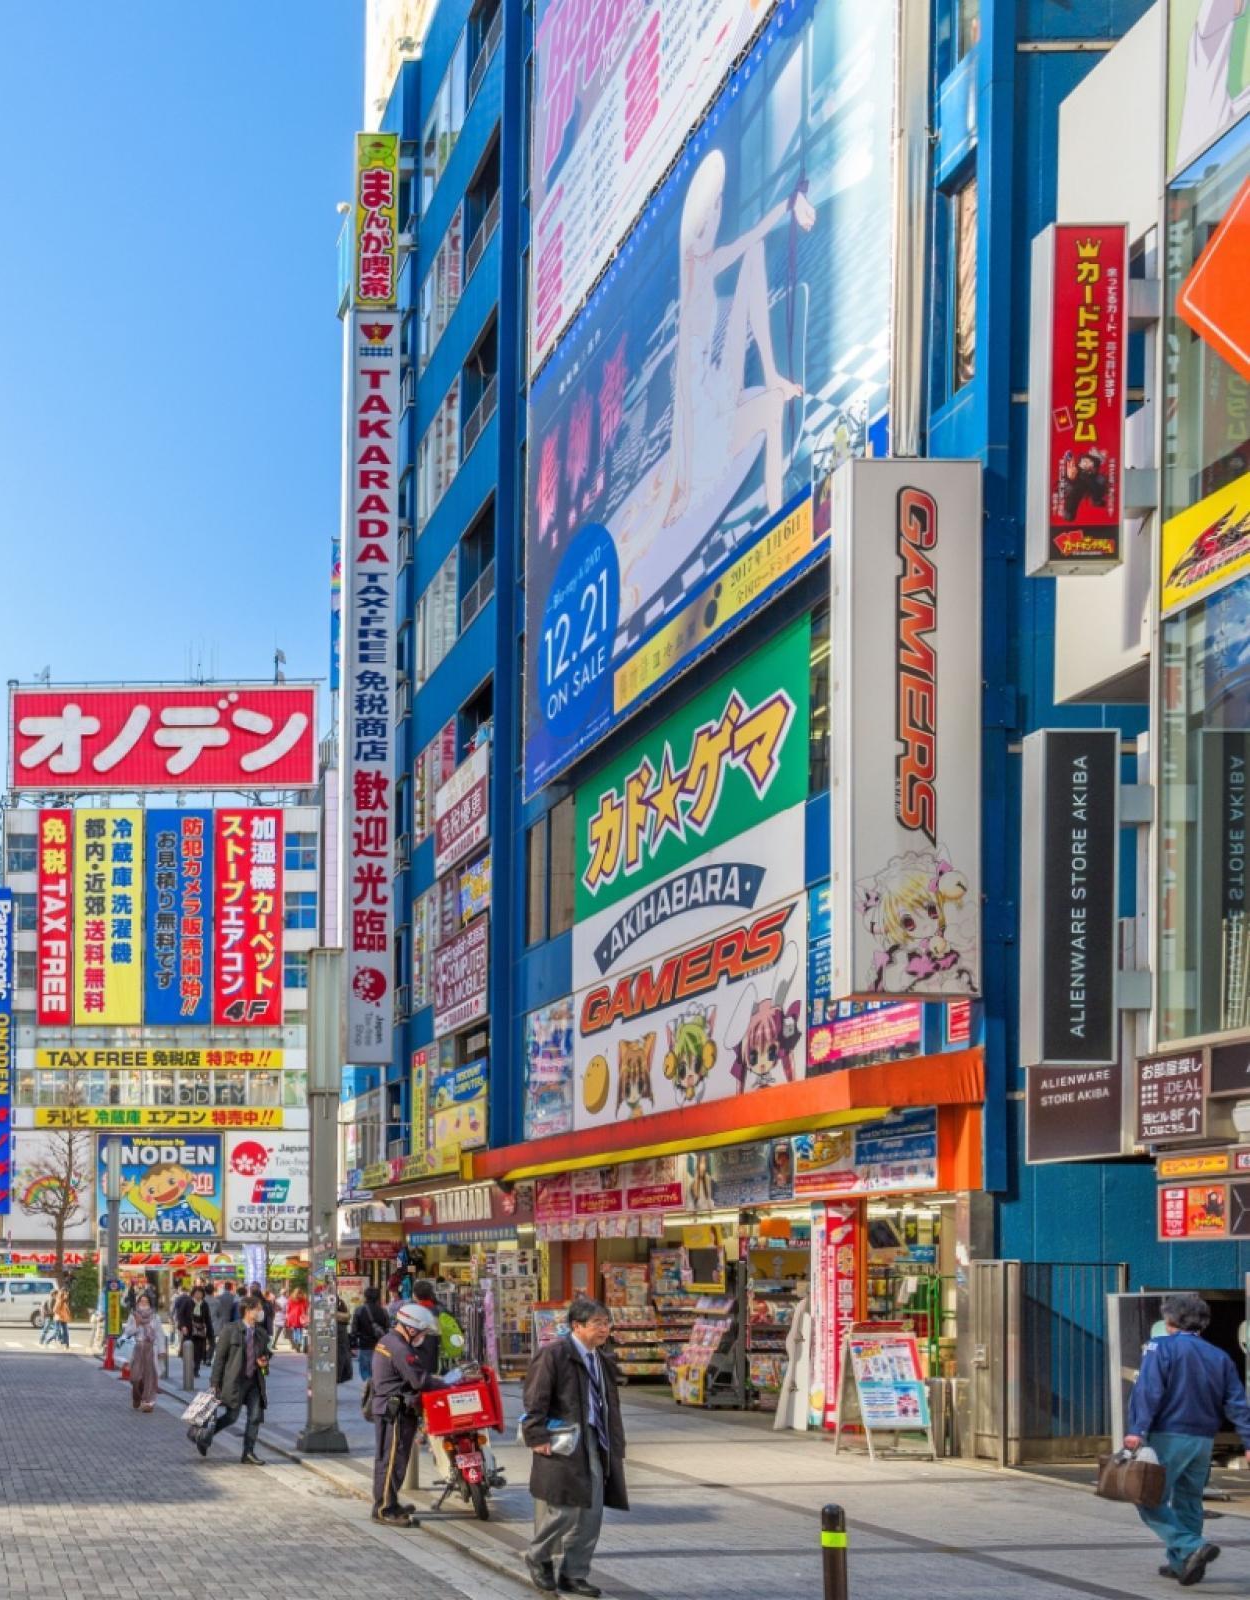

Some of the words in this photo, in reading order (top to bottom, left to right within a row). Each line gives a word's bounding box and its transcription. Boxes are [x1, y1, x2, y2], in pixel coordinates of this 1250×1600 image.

[359, 167, 395, 299] まんが喫茶
[1073, 260, 1101, 443] カードキングダム
[357, 368, 391, 564] TAKARADA
[544, 565, 608, 687] 12.21
[546, 682, 569, 720] ON
[572, 645, 606, 697] SALE
[895, 485, 938, 850] GAMERS
[18, 693, 309, 774] オノデン
[353, 669, 389, 763] 免税商店
[1072, 753, 1090, 822] AKIBA
[41, 818, 67, 874] 免税
[110, 818, 134, 887] 冷蔵庫
[351, 768, 389, 953] 歓迎光臨
[1070, 827, 1088, 901] STORE
[41, 878, 67, 933] TAX
[110, 893, 134, 964] 洗濯機
[155, 832, 177, 990] お見積り無料です
[220, 815, 246, 996] ストーブエアコン
[610, 866, 740, 962] AKIHABARA
[41, 940, 67, 1013] FREE
[579, 900, 800, 1038] GAMERS
[1069, 910, 1088, 1039] ALIENWARE
[223, 1000, 269, 1022] 4F
[46, 1051, 88, 1067] TAX
[93, 1051, 148, 1067] FREE
[152, 1050, 200, 1066] 免税店
[1040, 1067, 1112, 1090] ALIENWARE
[1141, 1056, 1203, 1081] お部屋探し
[46, 1109, 90, 1125] テレビ
[94, 1109, 142, 1125] 冷蔵庫
[146, 1109, 206, 1125] エアコン
[1040, 1090, 1076, 1106] STORE
[1076, 1087, 1111, 1103] AKIBA
[132, 1137, 168, 1147] Welcome
